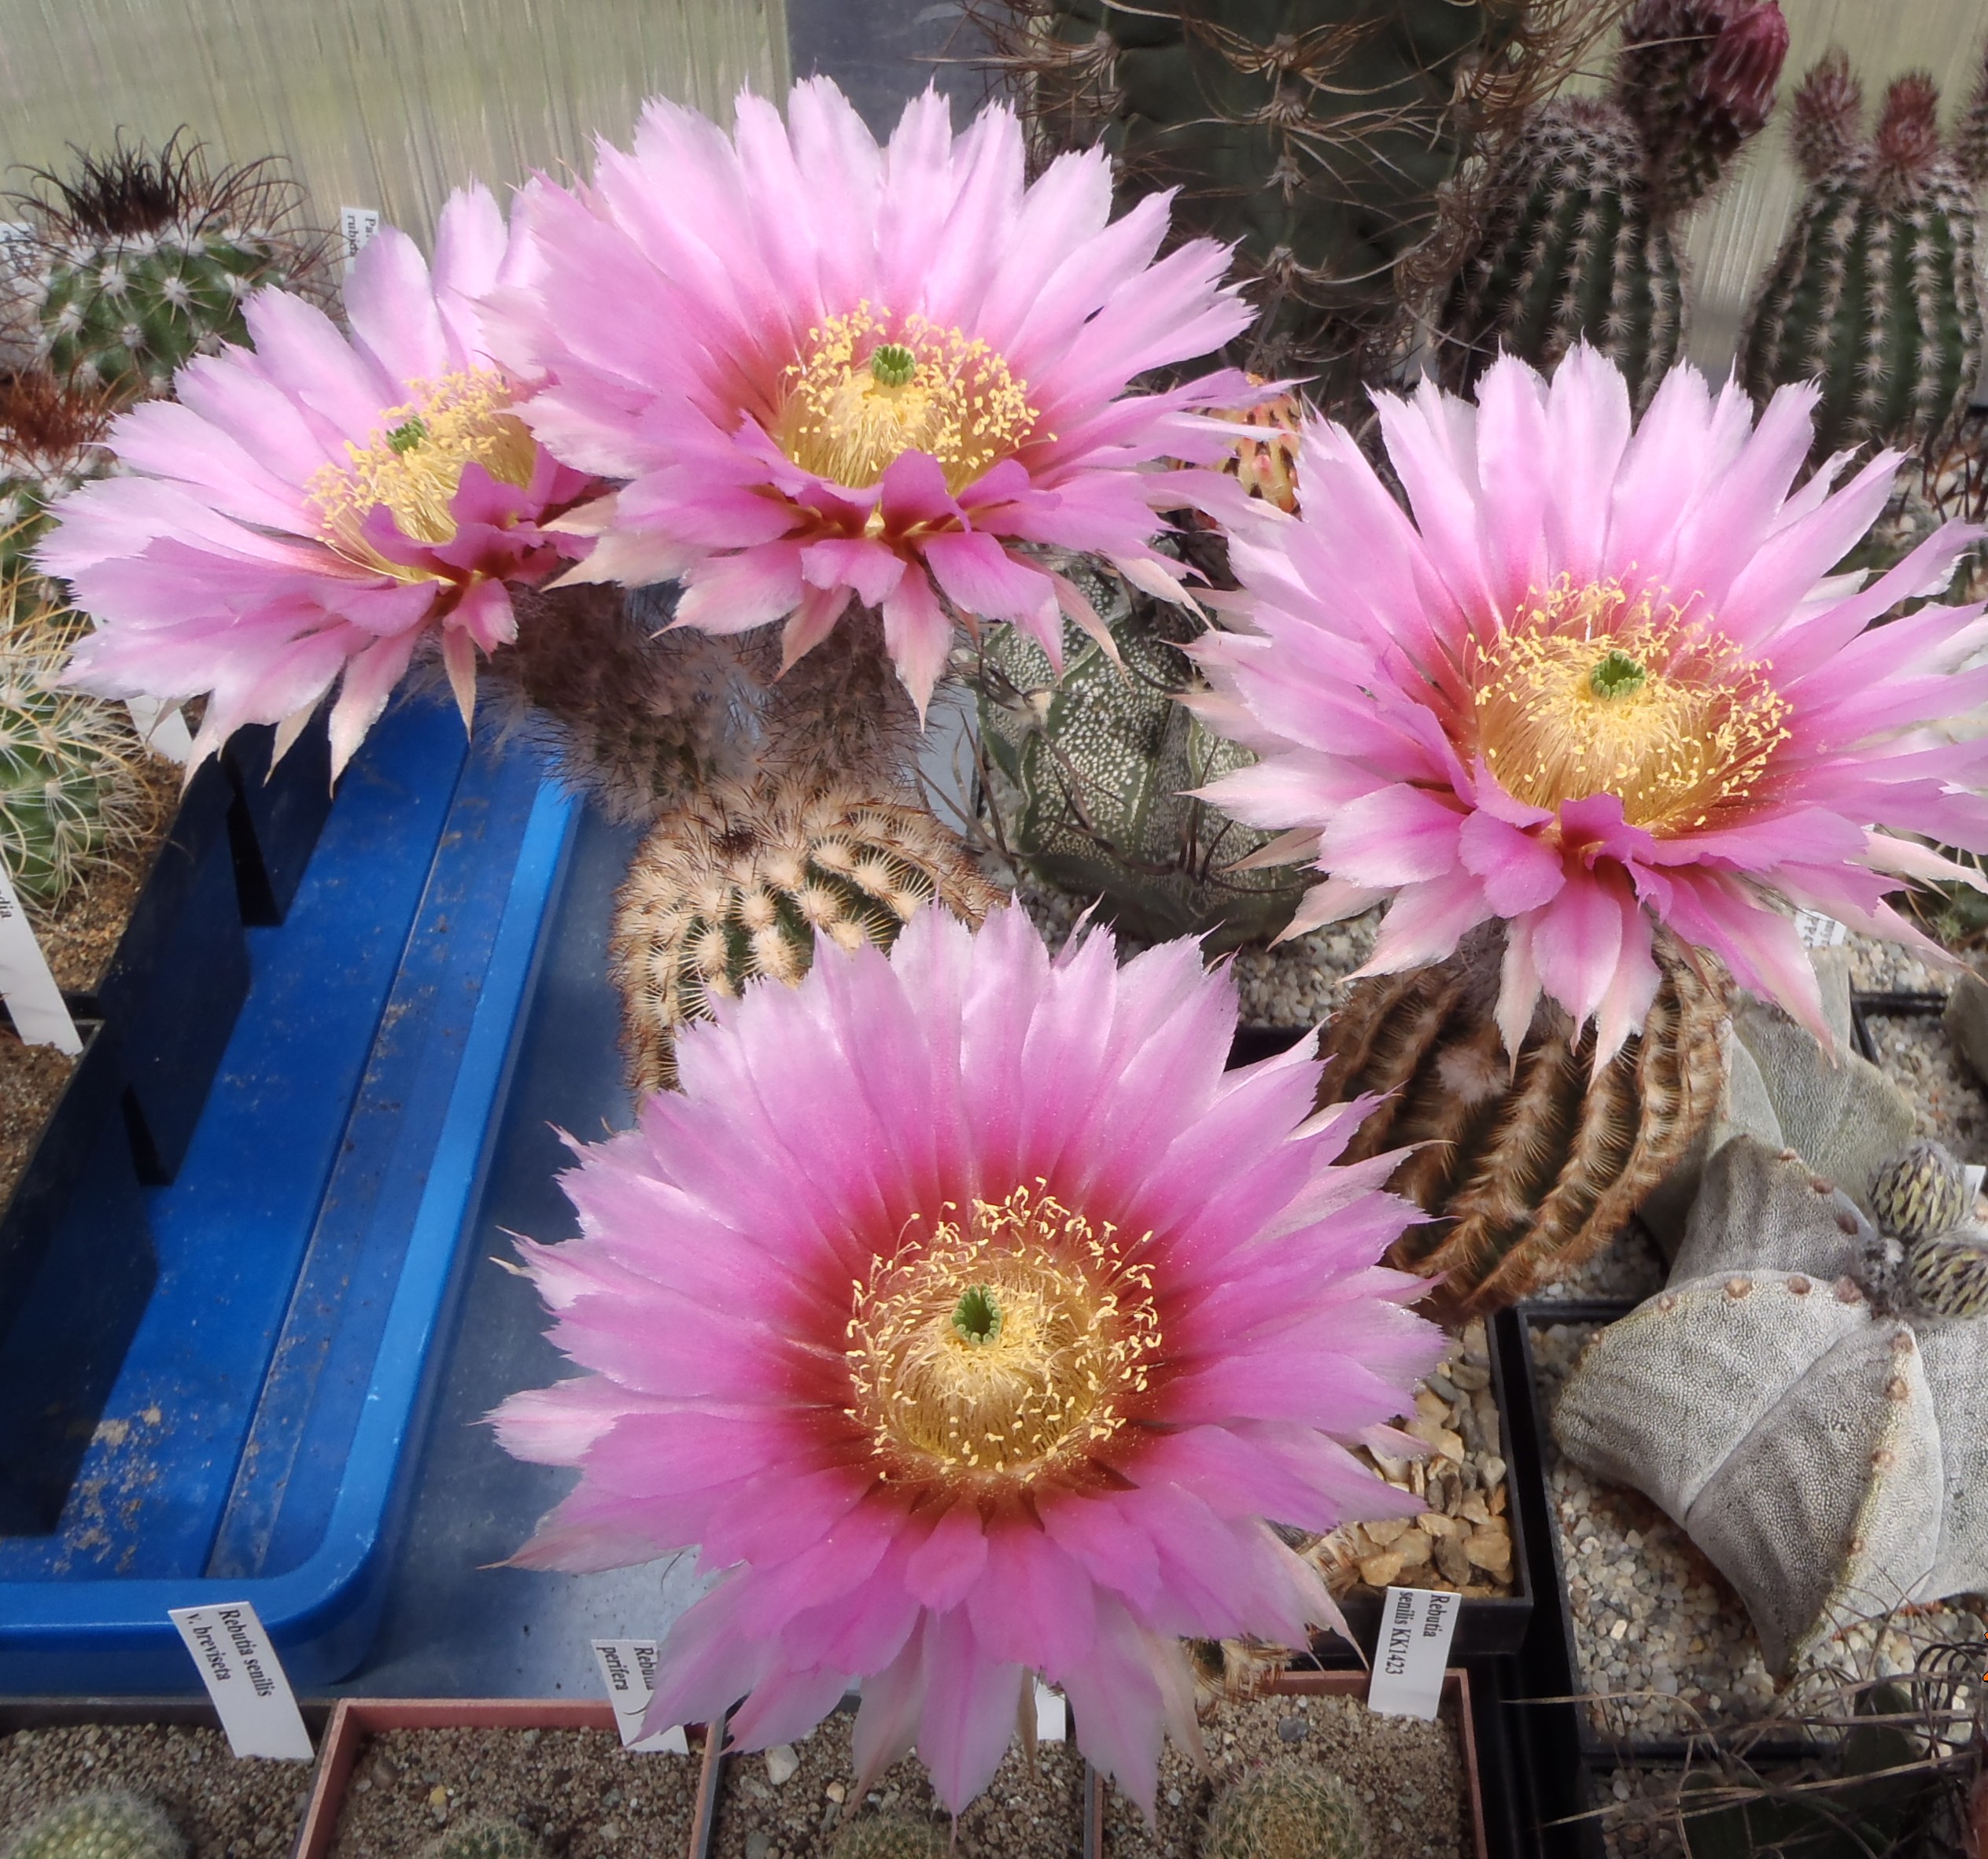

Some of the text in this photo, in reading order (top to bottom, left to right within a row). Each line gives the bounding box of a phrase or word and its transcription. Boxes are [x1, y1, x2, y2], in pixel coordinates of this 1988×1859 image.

[186, 1613, 232, 1682] v. breviseta
[1385, 1591, 1415, 1675] senilis KK1423
[1422, 1594, 1451, 1638] Rebutia
[219, 1609, 275, 1698] Rebutia senilis
[596, 1647, 630, 1691] perifera
